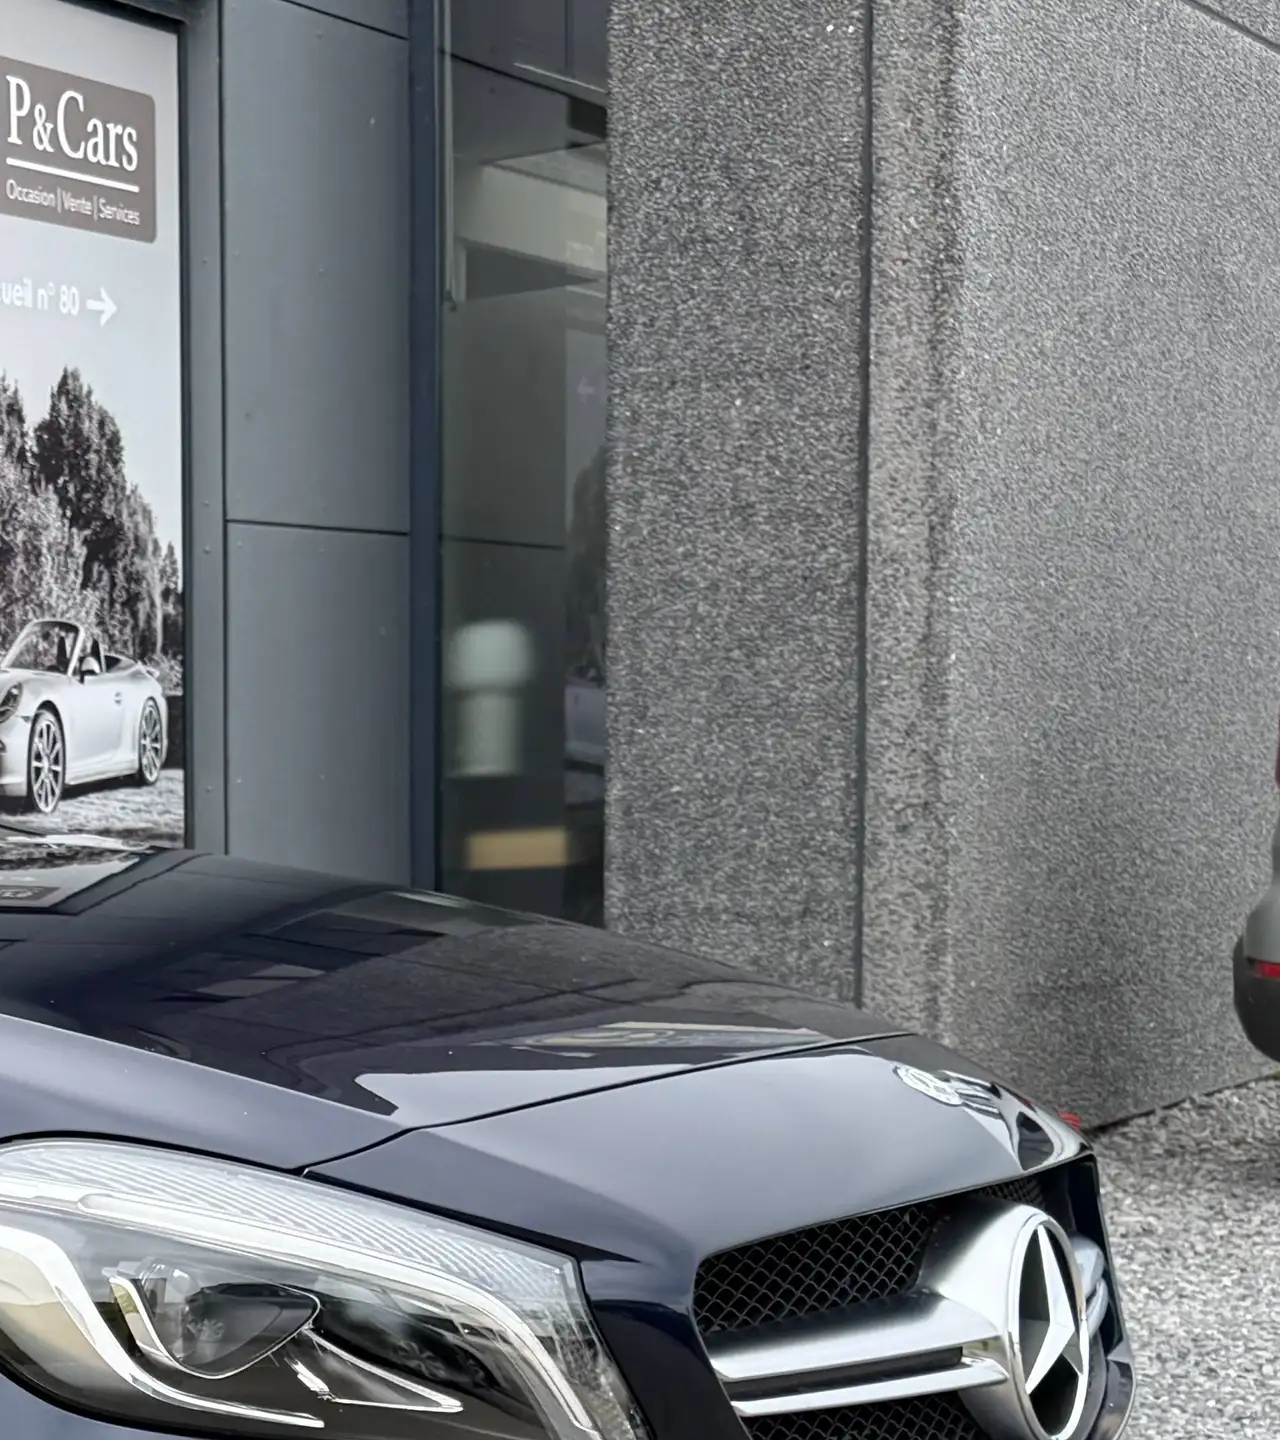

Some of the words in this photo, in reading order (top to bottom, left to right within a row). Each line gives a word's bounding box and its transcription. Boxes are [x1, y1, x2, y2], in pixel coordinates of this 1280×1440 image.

[5, 75, 139, 172] P&Cars
[5, 178, 56, 208] Occasion
[61, 189, 93, 216] Vente
[98, 197, 141, 226] Services
[58, 284, 80, 316] 80
